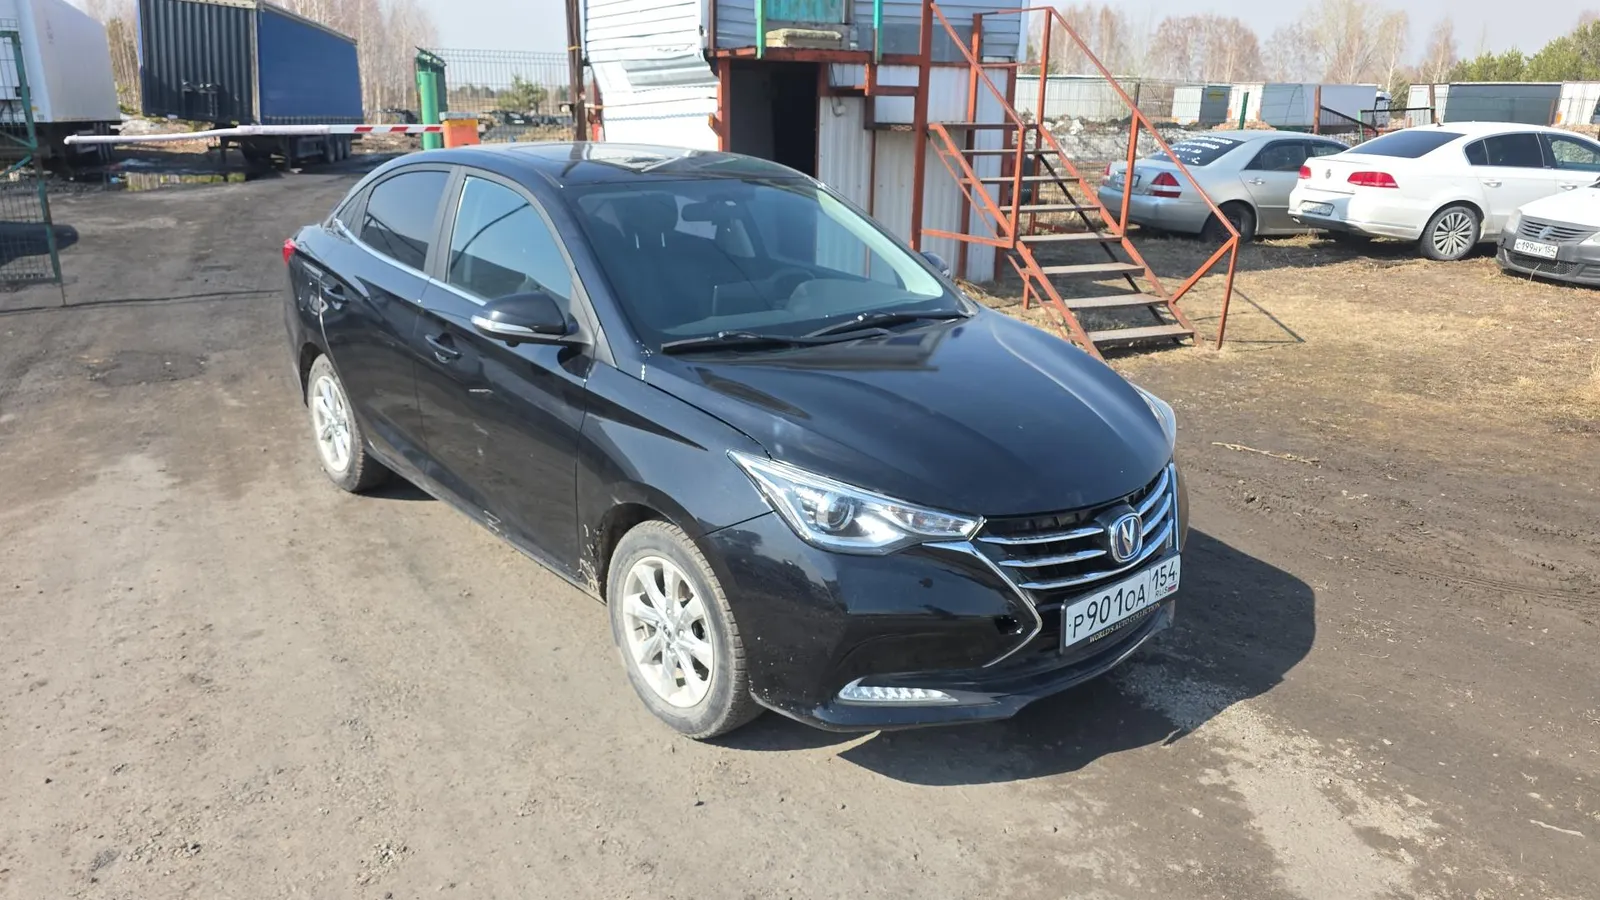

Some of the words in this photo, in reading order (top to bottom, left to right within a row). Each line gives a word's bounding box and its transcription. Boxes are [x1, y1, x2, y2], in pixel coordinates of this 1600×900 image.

[1155, 588, 1168, 597] RUS
[1073, 584, 1145, 638] Р901ОА
[1152, 561, 1177, 590] 154
[1115, 619, 1130, 630] AUTO
